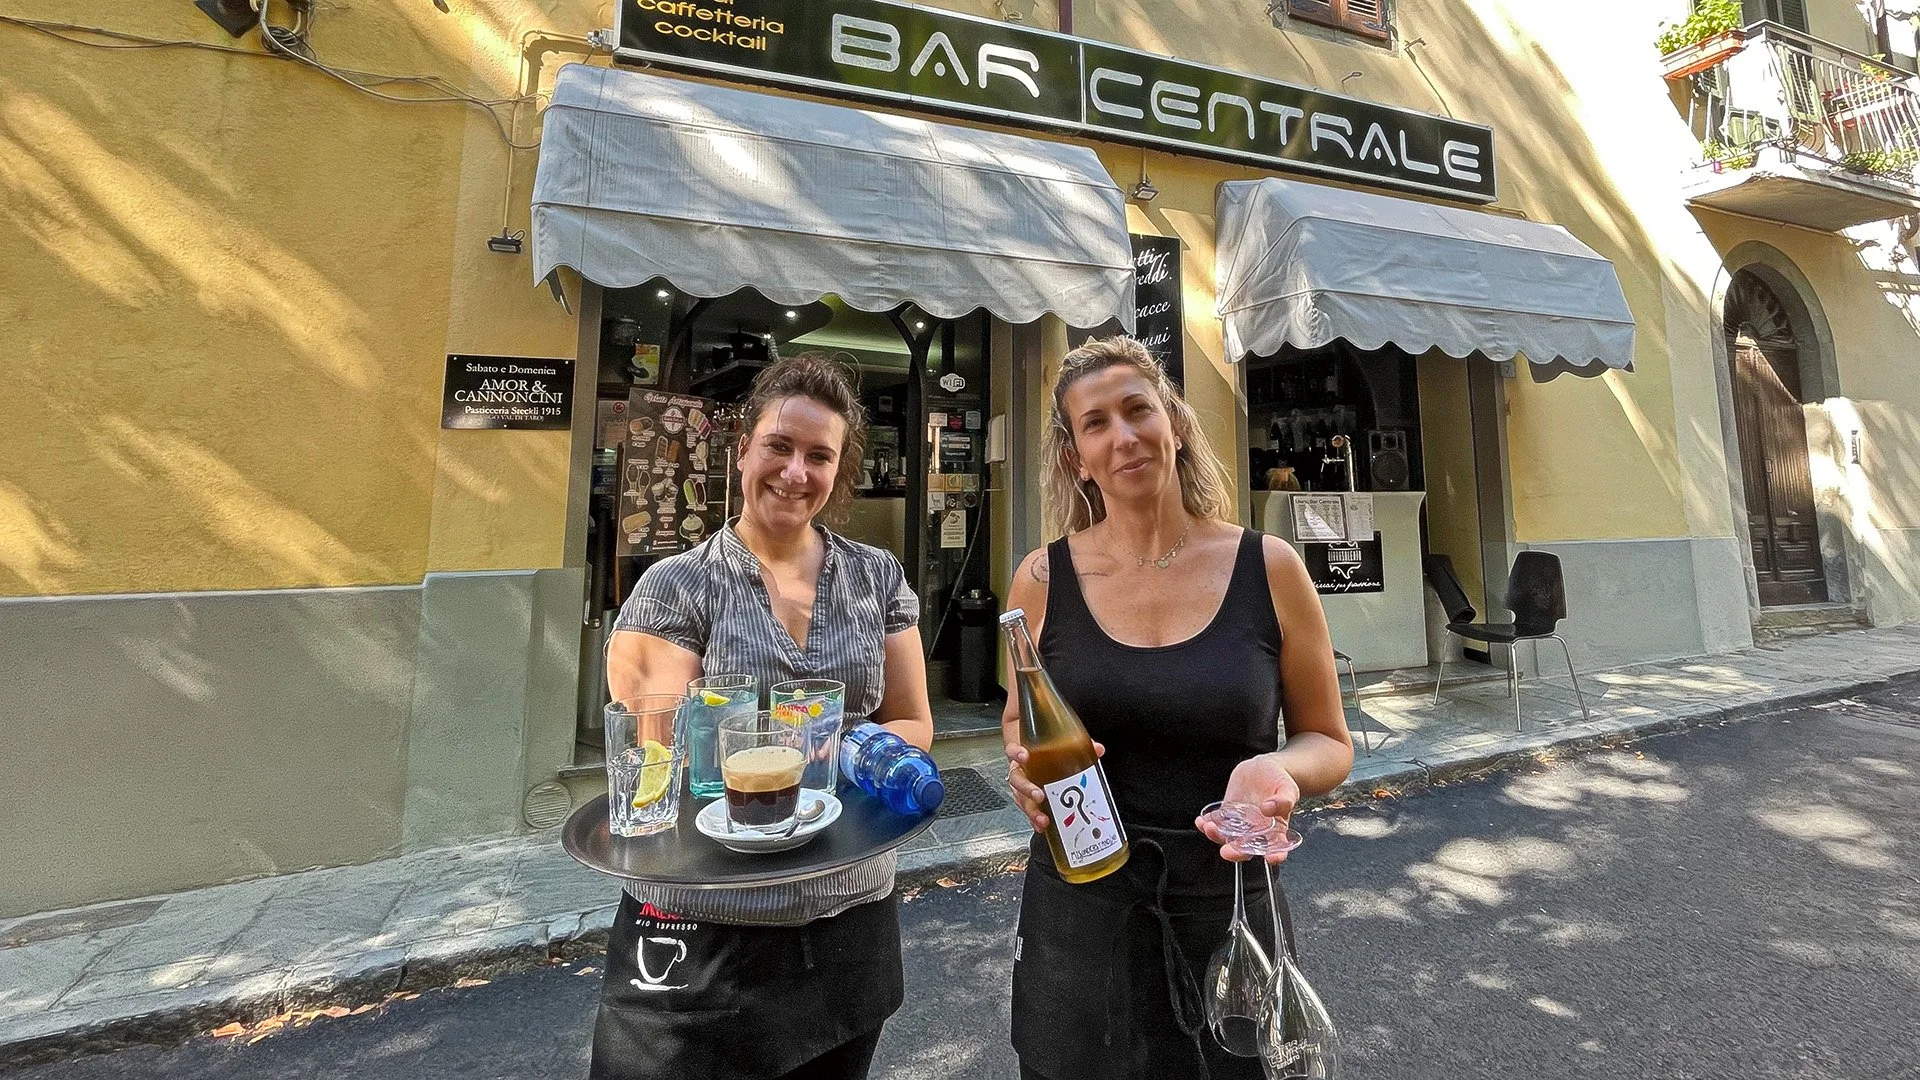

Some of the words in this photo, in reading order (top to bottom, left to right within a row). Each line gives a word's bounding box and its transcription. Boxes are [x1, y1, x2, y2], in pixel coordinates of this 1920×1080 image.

[637, 0, 784, 34] caffetteria
[654, 21, 767, 51] cocktail
[831, 13, 1040, 98] BAR
[1089, 67, 1481, 183] CENTRALE
[466, 363, 499, 373] Sabato
[509, 365, 556, 375] Domenica
[480, 379, 529, 391] AMOR
[531, 380, 547, 393] &
[454, 390, 563, 404] CANNONCINI
[465, 406, 510, 415] Pasticceria
[541, 407, 561, 416] 1915
[1344, 578, 1381, 592] passione
[635, 919, 650, 927] MIO
[656, 922, 698, 931] ESPRESSO
